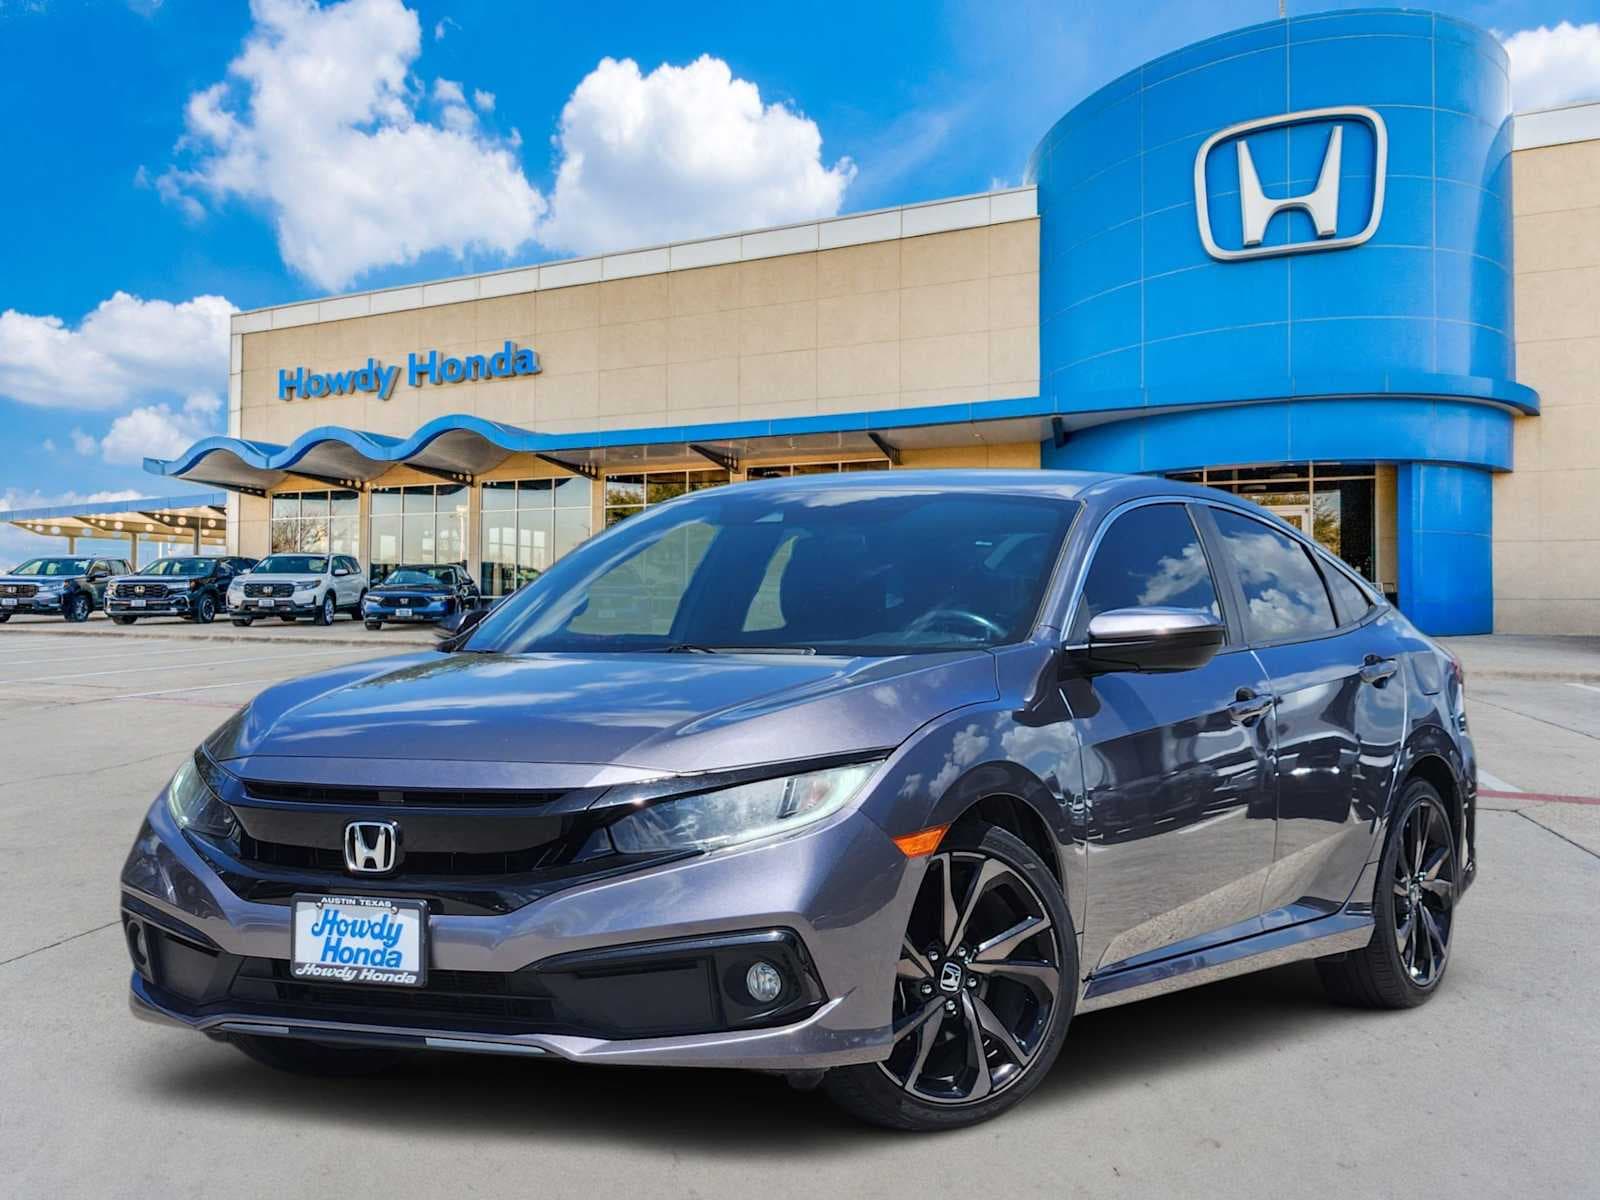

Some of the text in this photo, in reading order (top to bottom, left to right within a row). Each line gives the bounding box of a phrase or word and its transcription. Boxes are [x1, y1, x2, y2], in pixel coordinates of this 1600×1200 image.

[278, 340, 540, 400] Howdy Honda
[320, 897, 392, 908] AUSTIN TEXAS
[311, 908, 403, 948] Howdy
[320, 936, 403, 968] Honda
[295, 963, 417, 984] Howdy Honda
